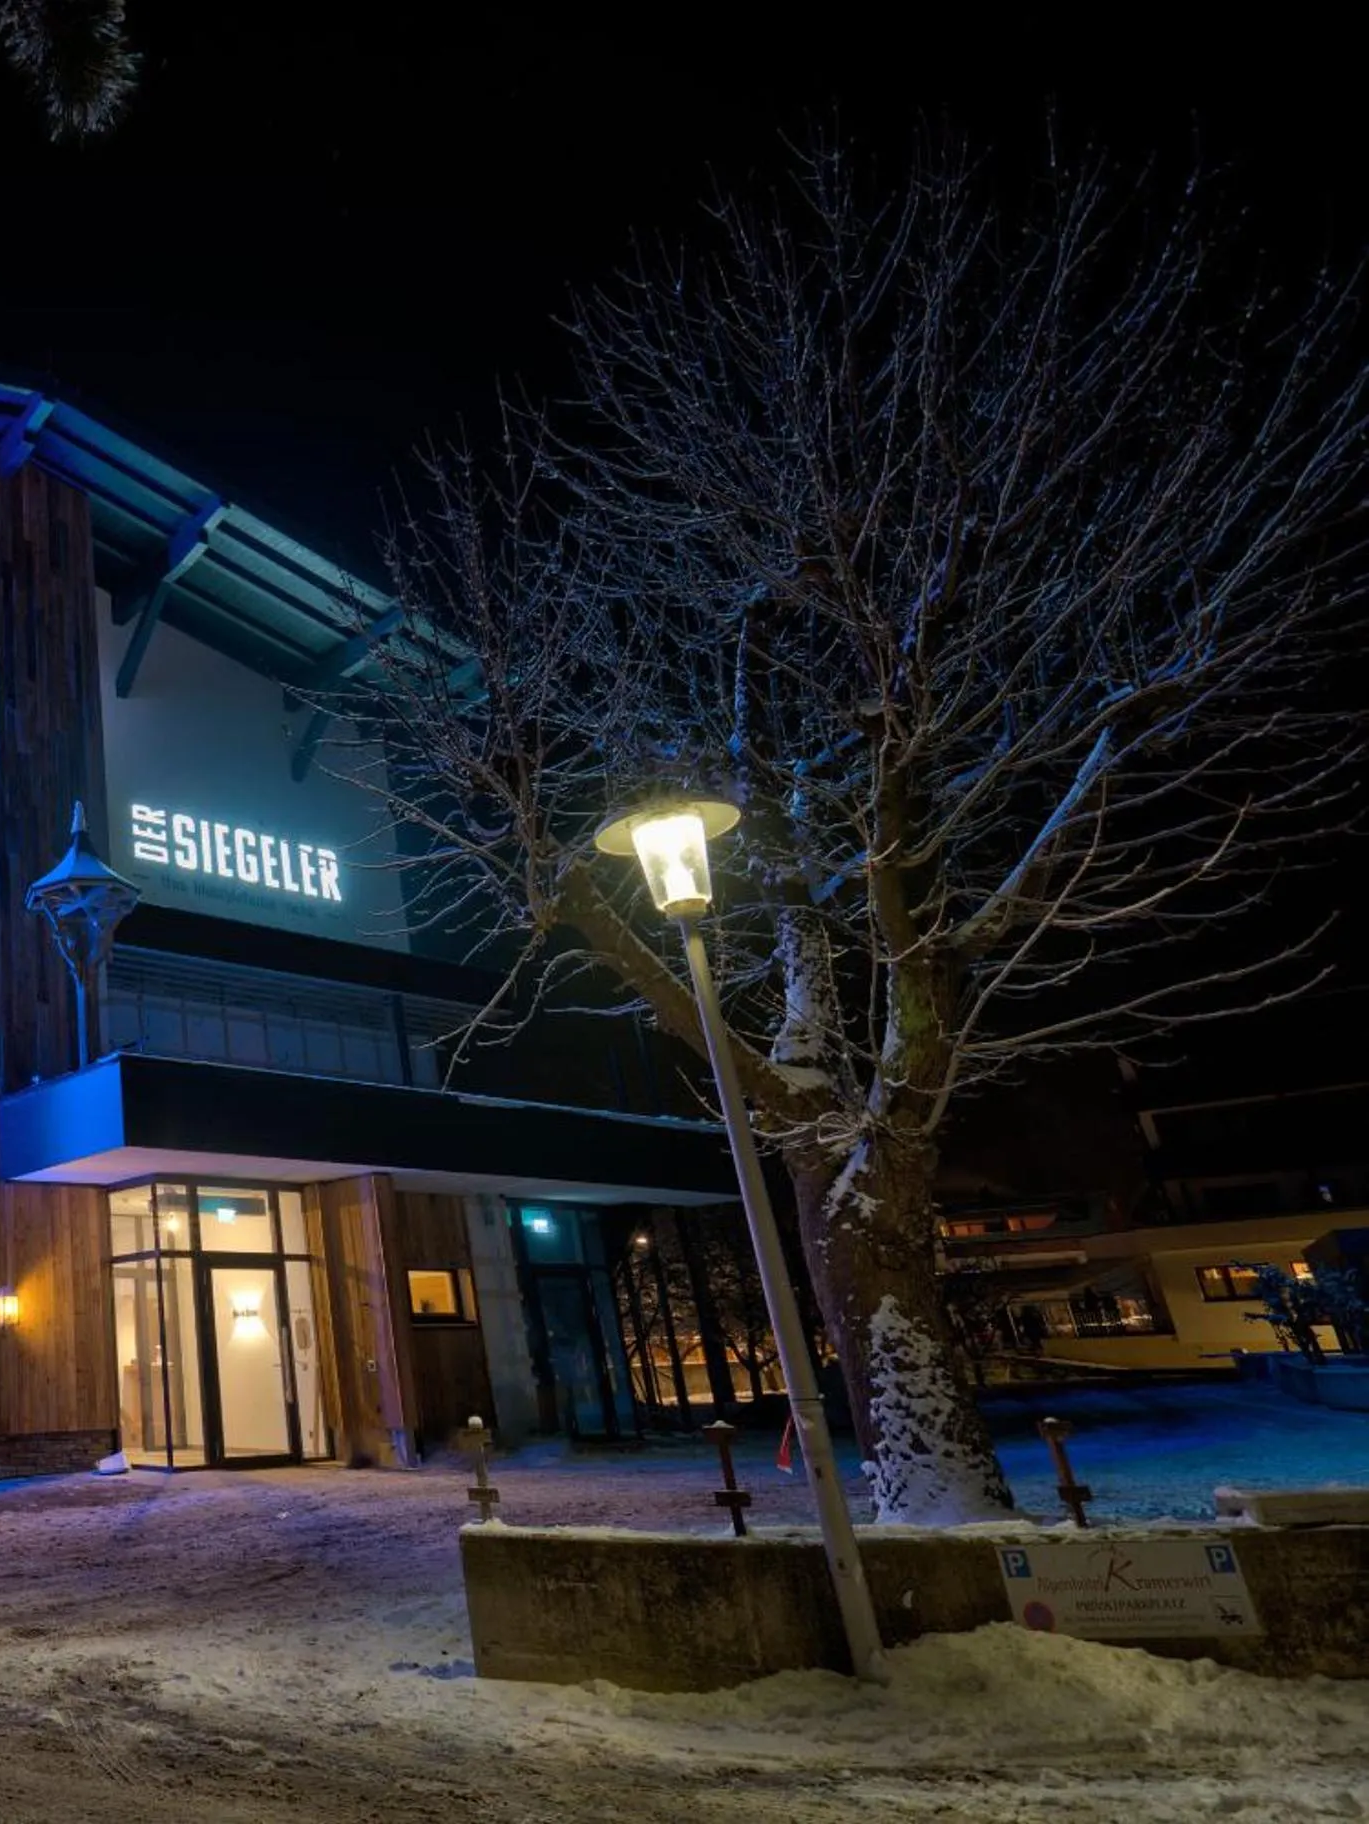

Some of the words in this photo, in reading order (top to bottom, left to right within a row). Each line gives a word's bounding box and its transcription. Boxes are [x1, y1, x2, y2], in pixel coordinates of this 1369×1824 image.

[131, 803, 169, 865] DER
[172, 813, 342, 902] SIEGELER
[1008, 1551, 1025, 1575] P
[1212, 1547, 1228, 1572] P
